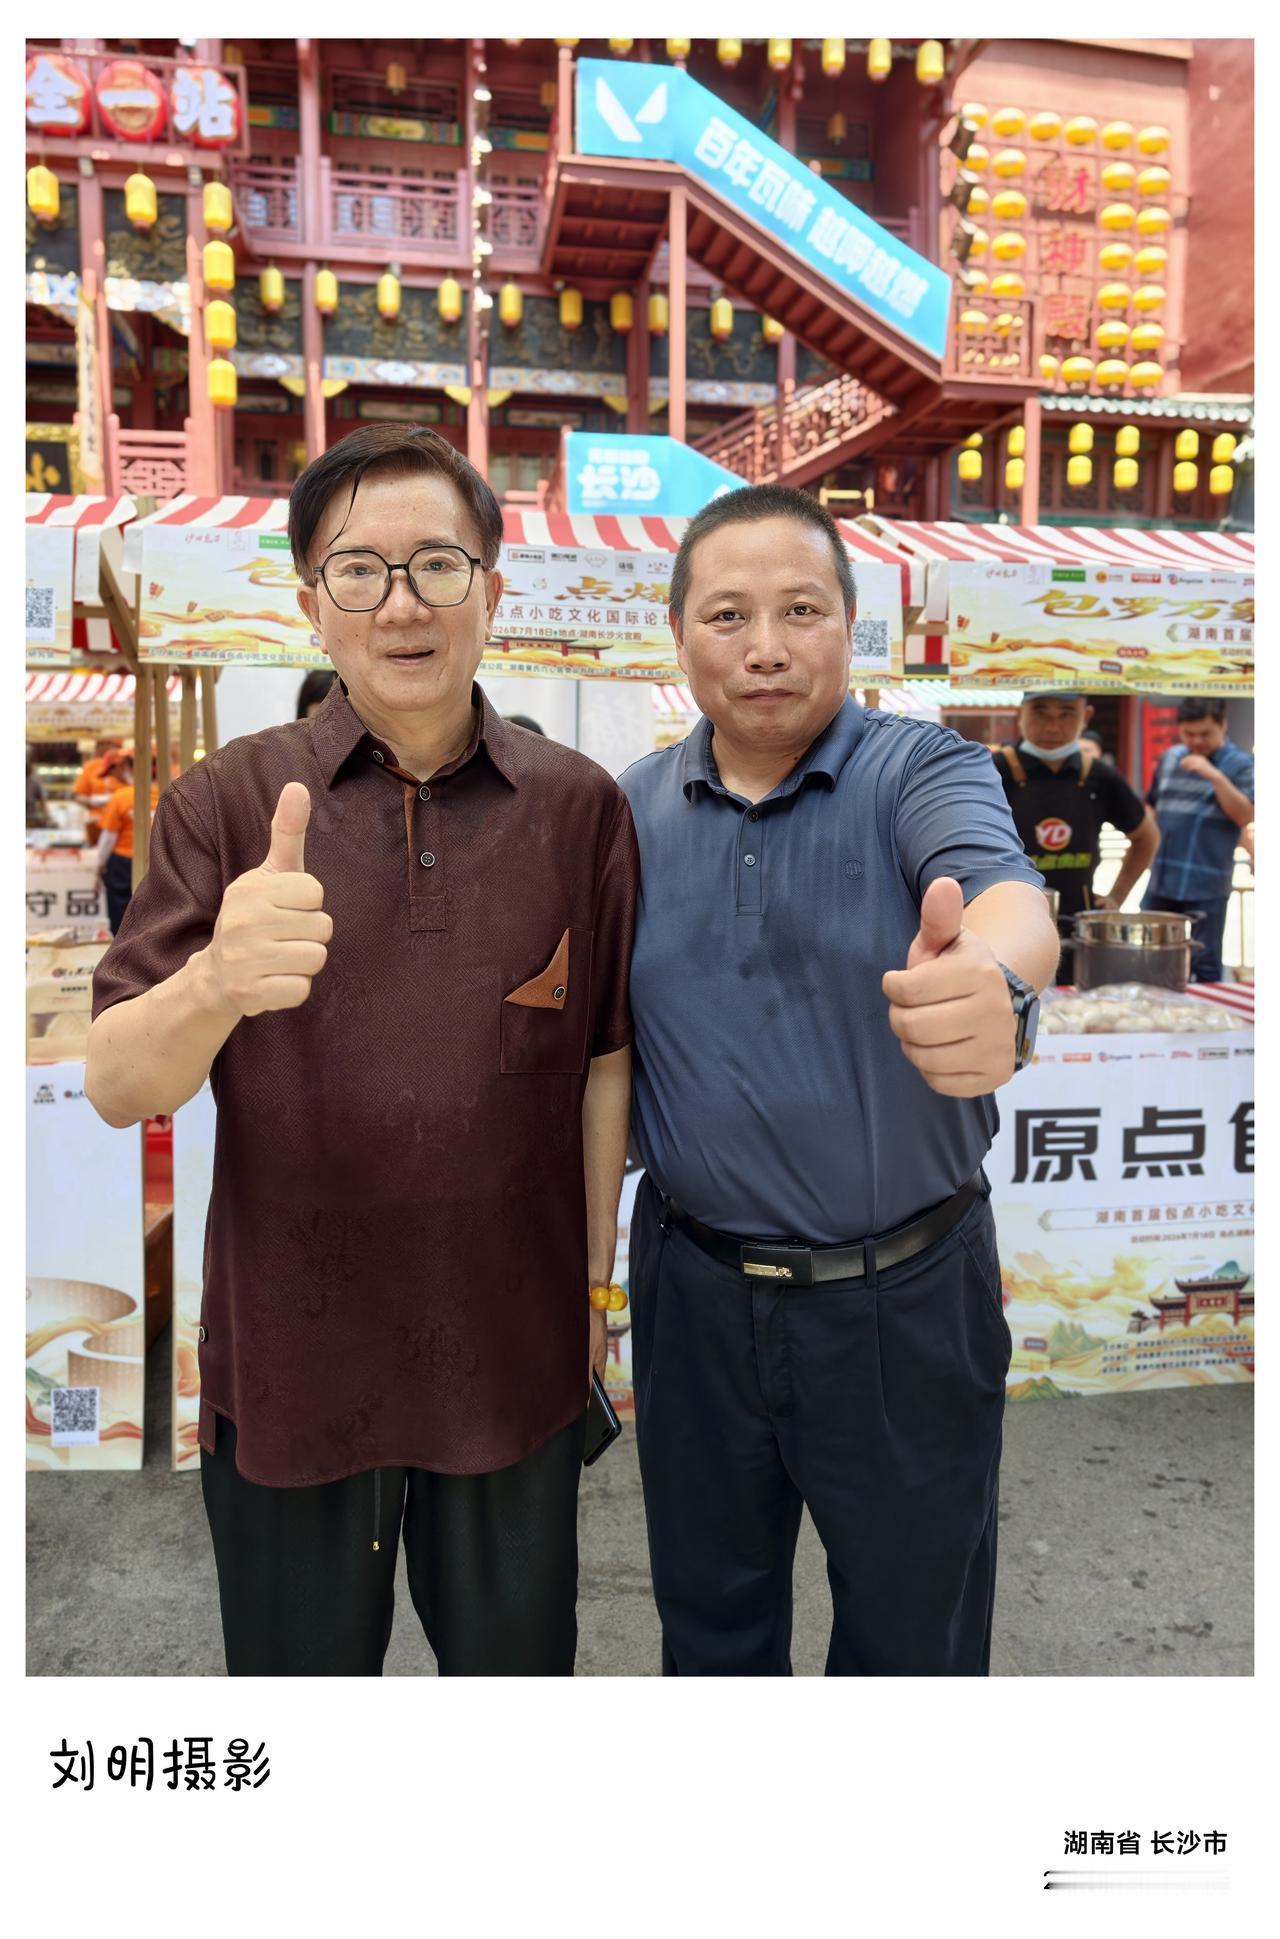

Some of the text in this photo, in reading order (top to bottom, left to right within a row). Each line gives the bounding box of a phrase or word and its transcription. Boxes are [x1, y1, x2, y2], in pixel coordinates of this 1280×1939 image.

[577, 464, 661, 500] 长沙
[1035, 824, 1072, 846] YD
[26, 890, 99, 917] 守品
